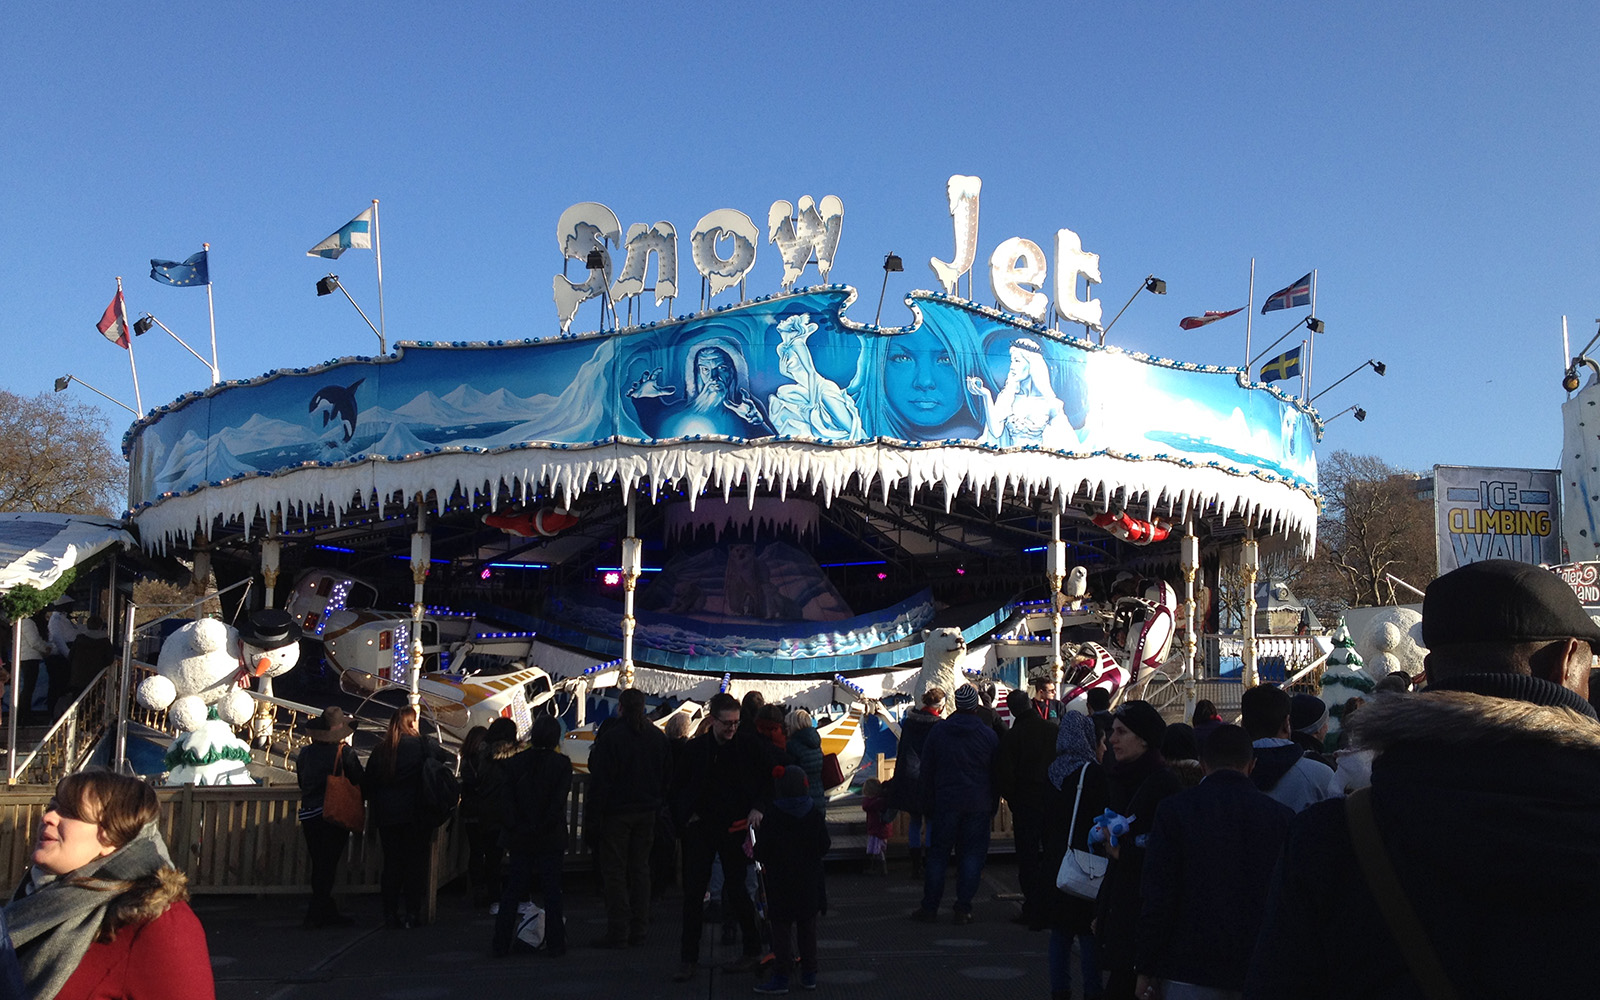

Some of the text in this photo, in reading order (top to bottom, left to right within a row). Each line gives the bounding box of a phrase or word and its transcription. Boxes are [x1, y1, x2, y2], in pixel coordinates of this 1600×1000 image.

[553, 174, 1103, 331] Snow Jet
[1480, 481, 1519, 510] ICE
[1448, 508, 1550, 536] CLIMBING
